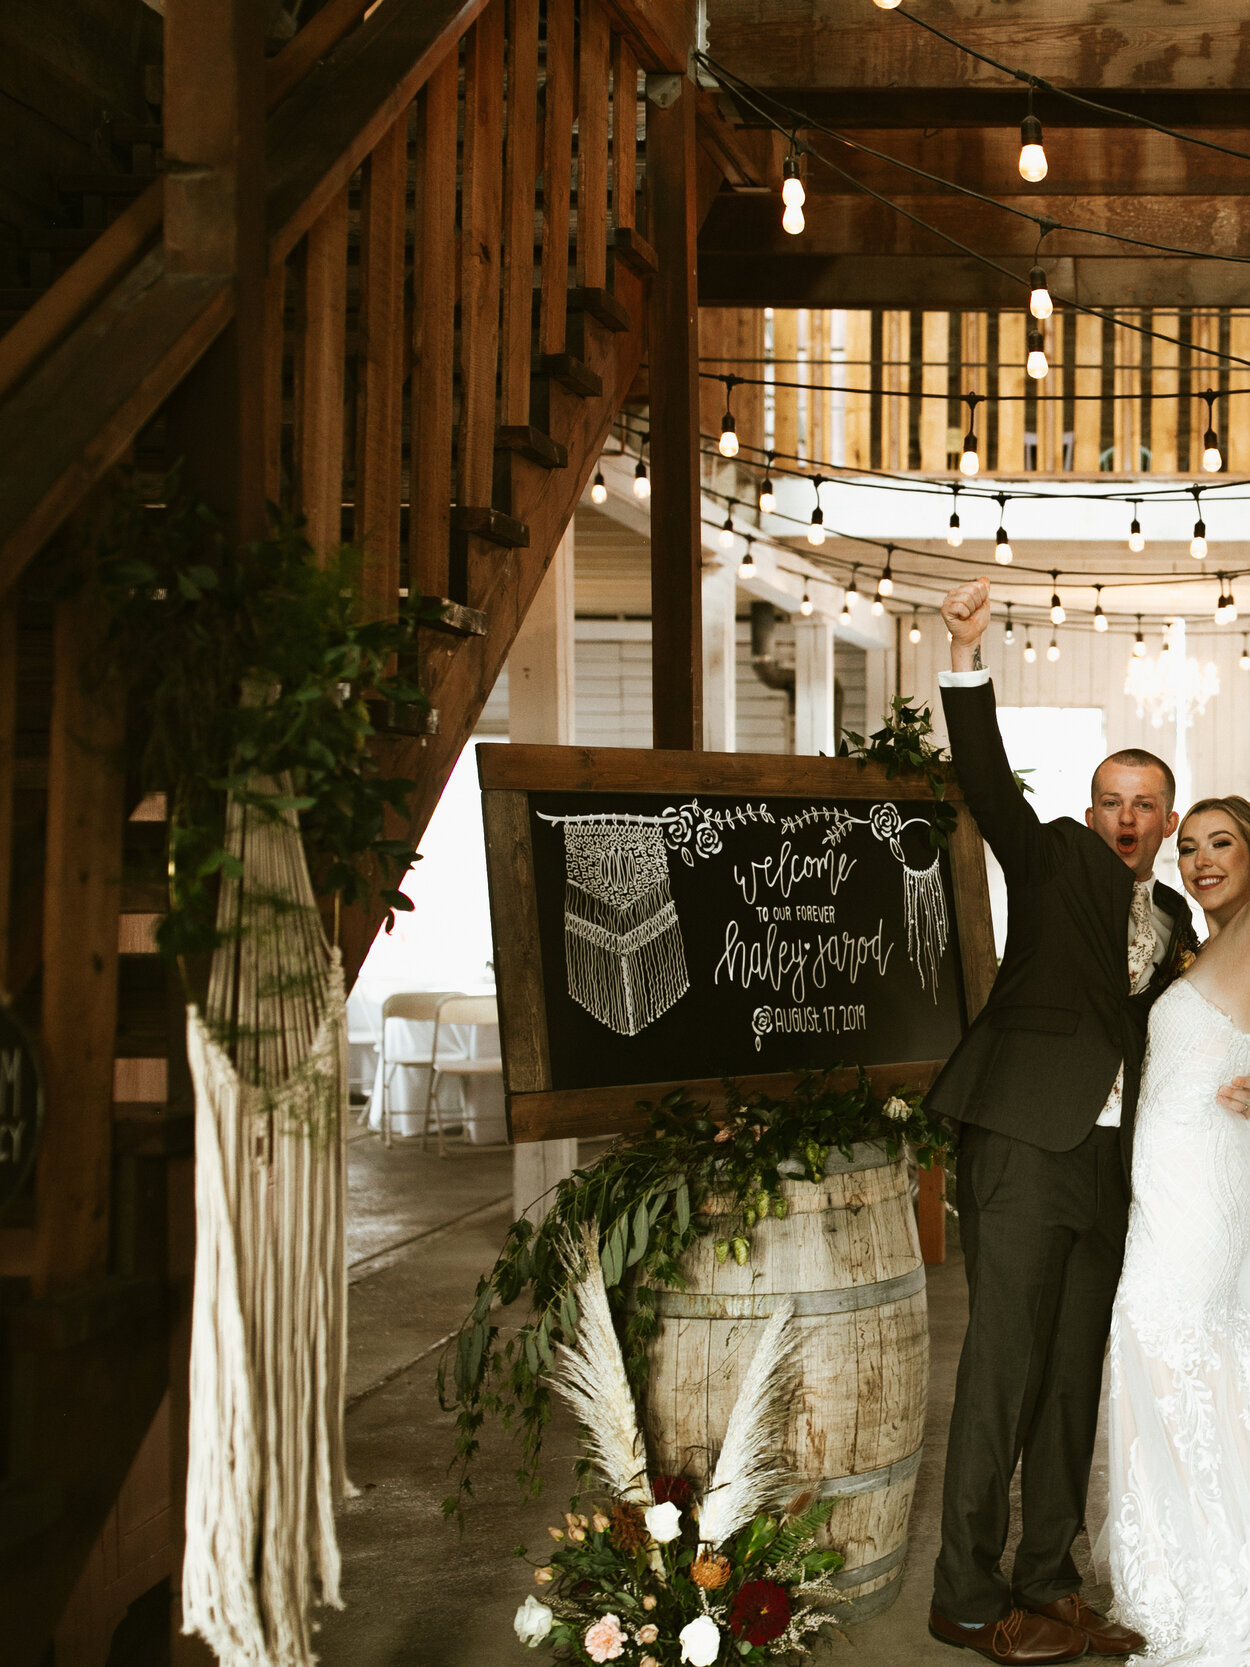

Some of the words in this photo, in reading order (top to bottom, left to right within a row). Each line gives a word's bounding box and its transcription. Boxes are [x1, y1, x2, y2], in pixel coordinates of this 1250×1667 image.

[733, 840, 858, 905] welcome
[755, 905, 769, 924] TO
[772, 905, 792, 921] OUR
[795, 905, 836, 924] FOREVER
[714, 919, 808, 1004] haley
[822, 1005, 840, 1035] 17,
[839, 1003, 867, 1031] 2019
